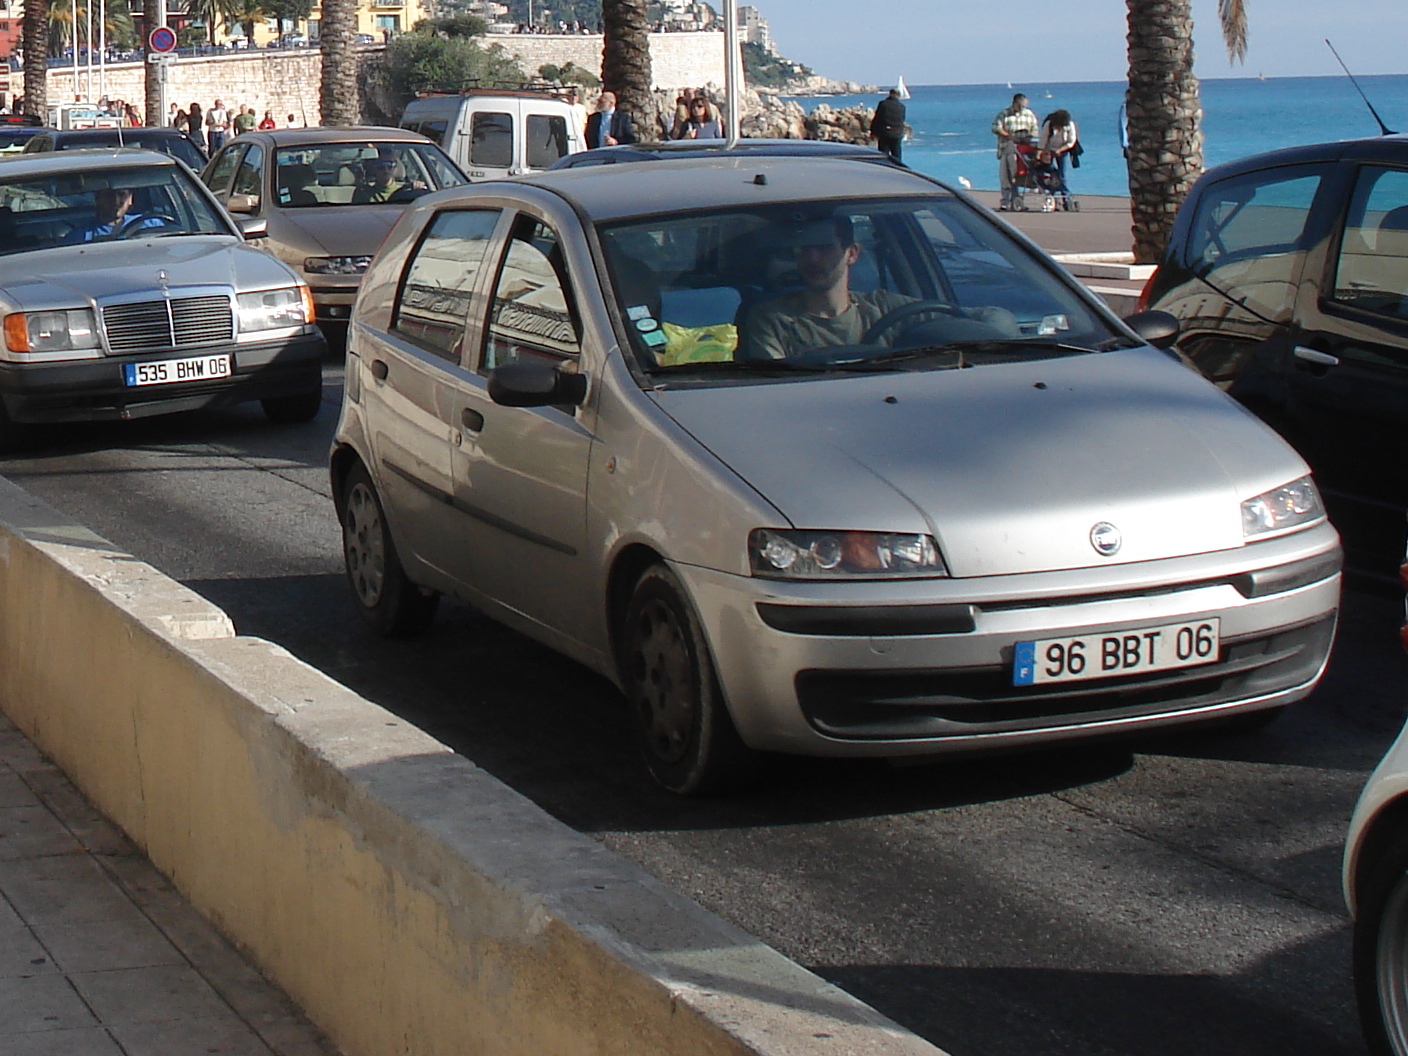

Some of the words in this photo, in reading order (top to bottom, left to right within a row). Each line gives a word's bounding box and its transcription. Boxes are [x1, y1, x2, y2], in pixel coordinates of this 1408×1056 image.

[138, 364, 168, 382] 535
[176, 360, 204, 378] BHW
[209, 357, 227, 375] 06
[1045, 641, 1086, 677] 96
[1101, 631, 1161, 671] BBT
[1176, 624, 1213, 660] 06
